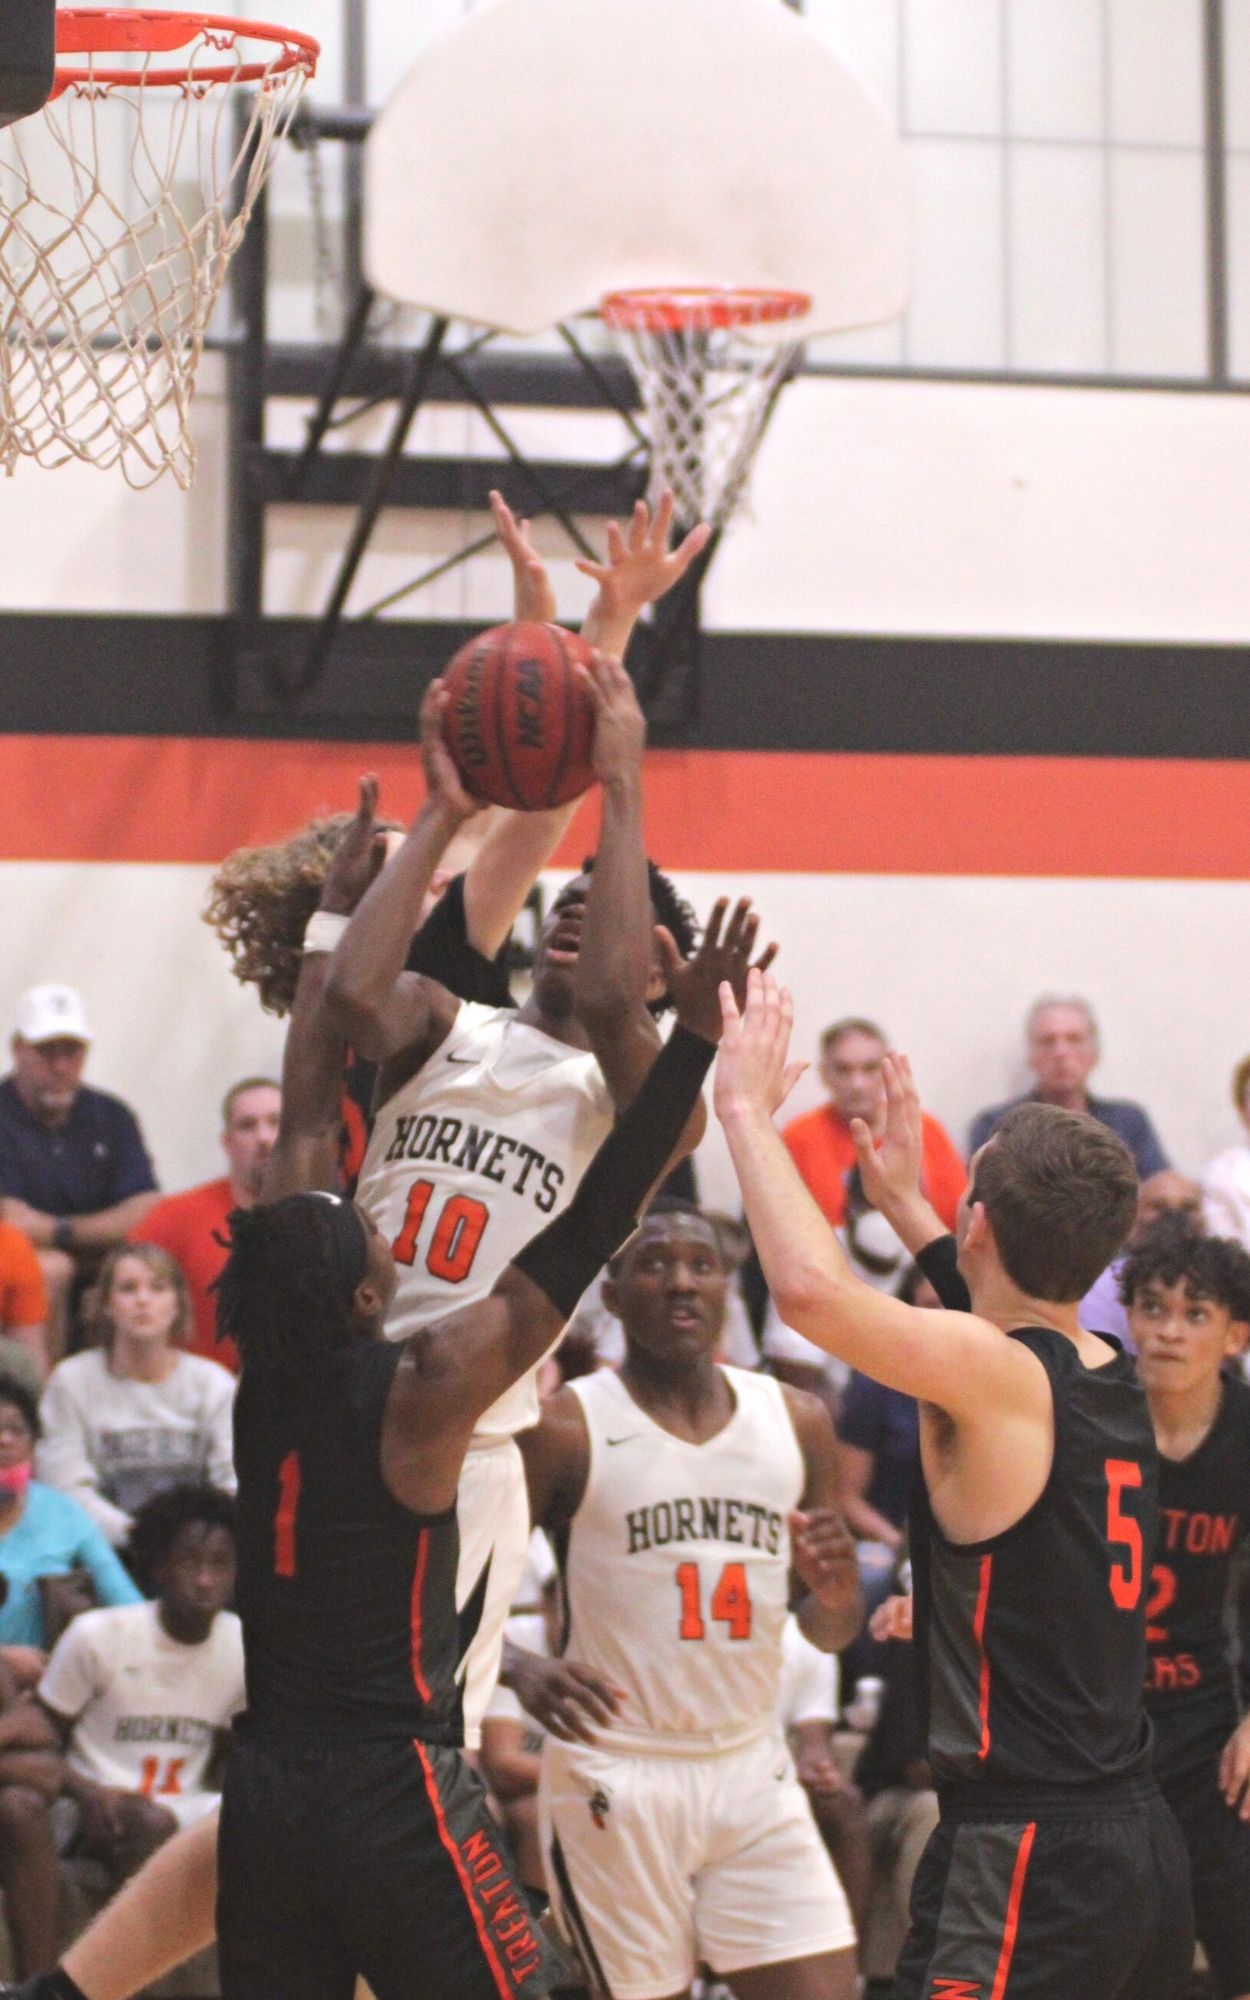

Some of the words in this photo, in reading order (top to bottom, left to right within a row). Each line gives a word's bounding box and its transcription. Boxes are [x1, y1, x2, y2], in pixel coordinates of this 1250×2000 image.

[514, 657, 546, 749] NCAA
[385, 1114, 565, 1213] HORNETS
[391, 1178, 490, 1284] 10
[626, 1497, 782, 1555] HORNETS
[1104, 1458, 1143, 1610] 5
[1158, 1508, 1239, 1556] TON
[676, 1562, 752, 1640] 14
[462, 1828, 541, 1985] TRENTON
